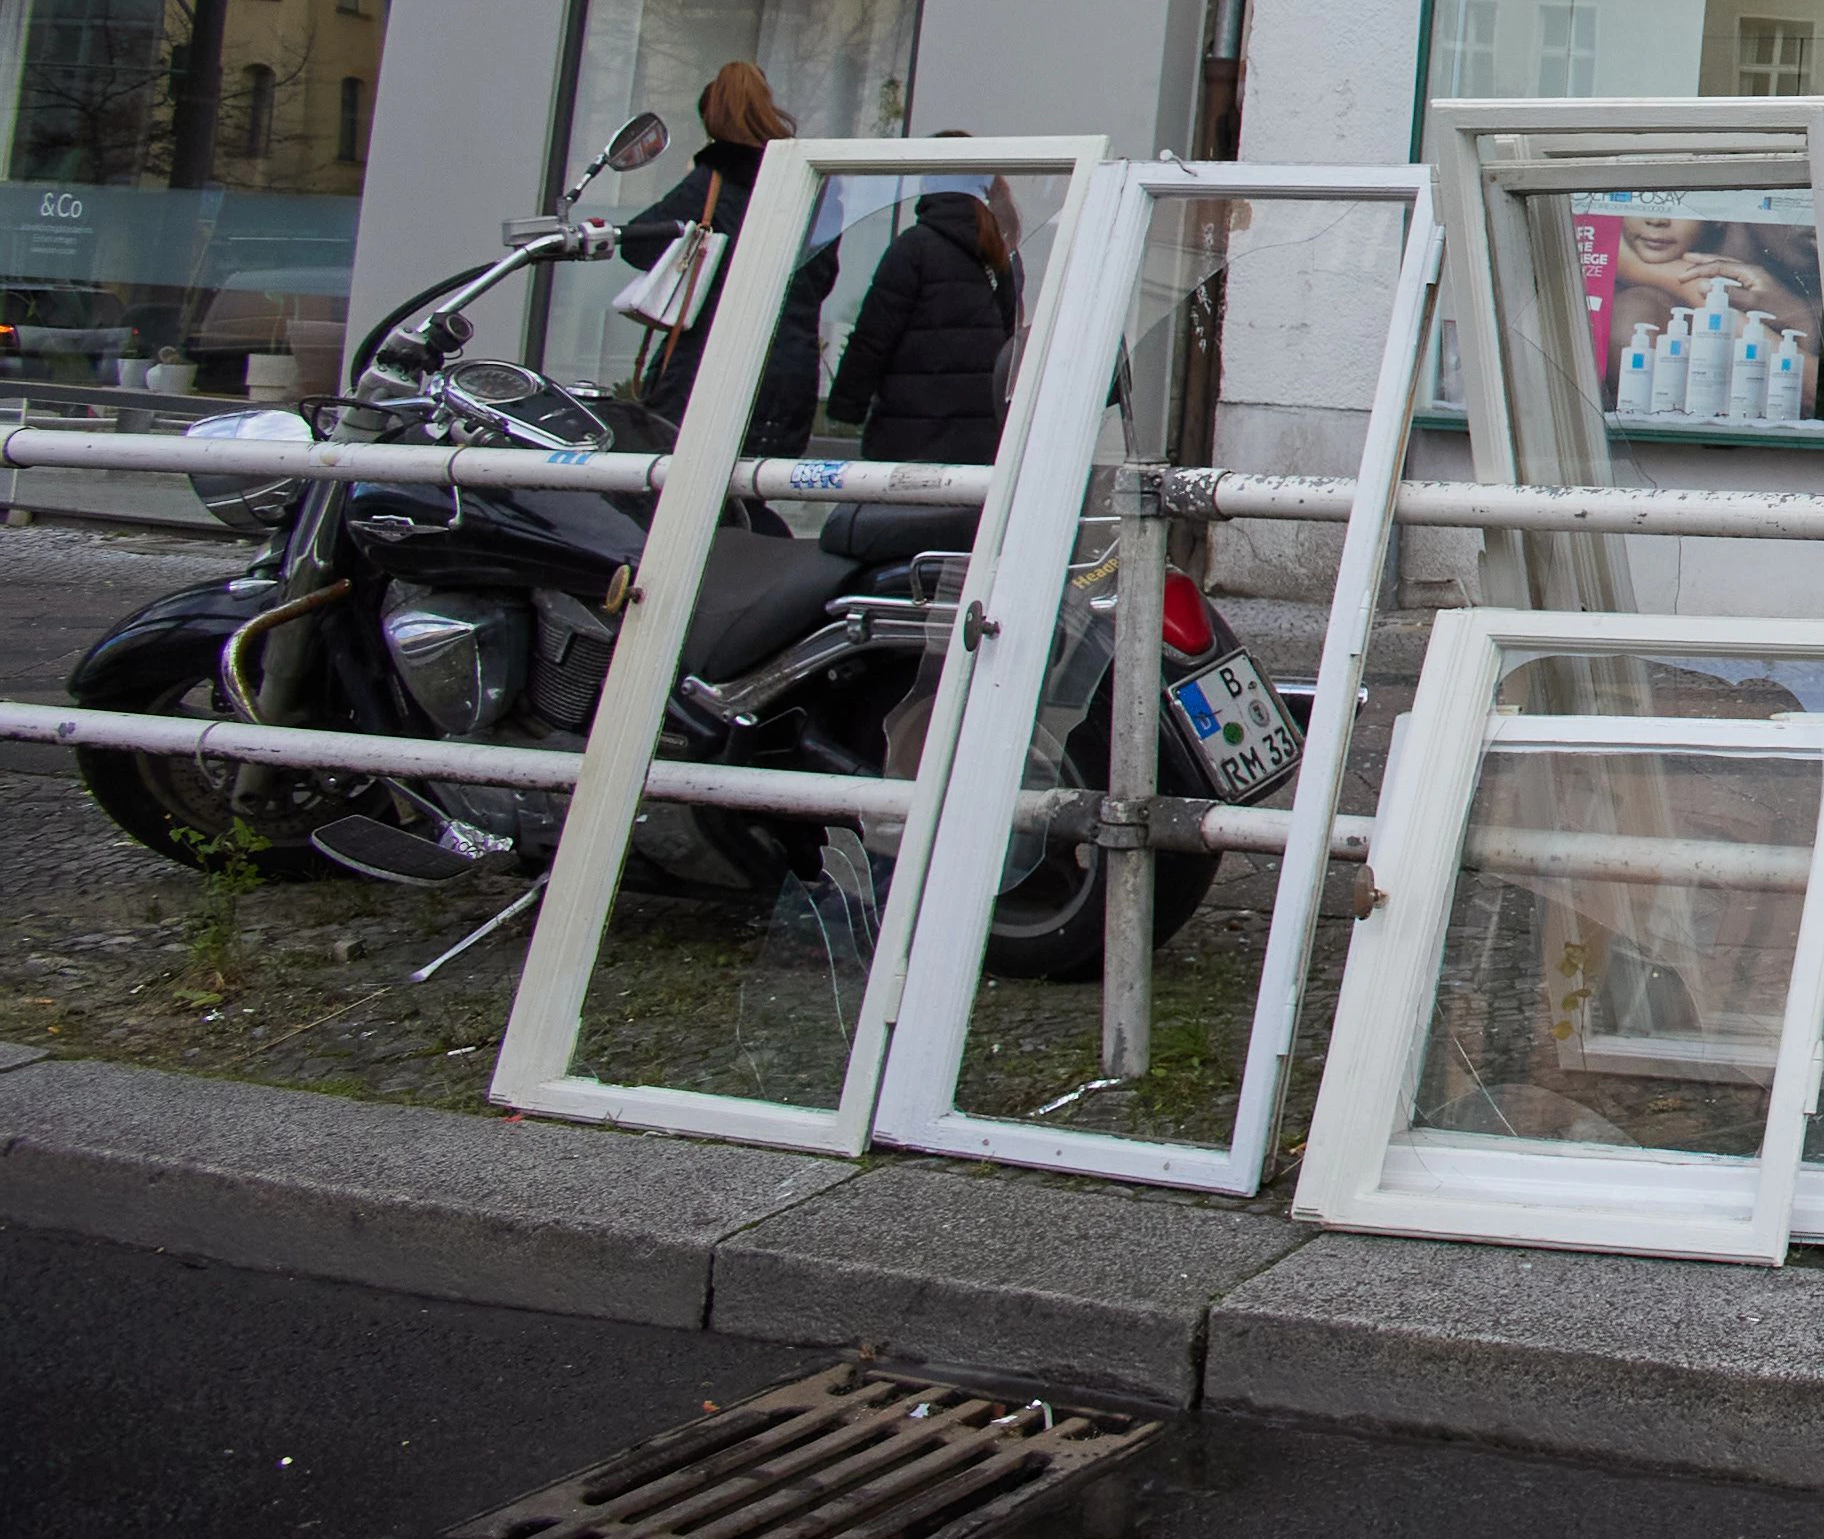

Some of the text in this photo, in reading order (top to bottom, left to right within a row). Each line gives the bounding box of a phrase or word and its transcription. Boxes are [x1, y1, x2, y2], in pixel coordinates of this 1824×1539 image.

[1220, 667, 1243, 699] B
[1220, 725, 1296, 794] RM 33
